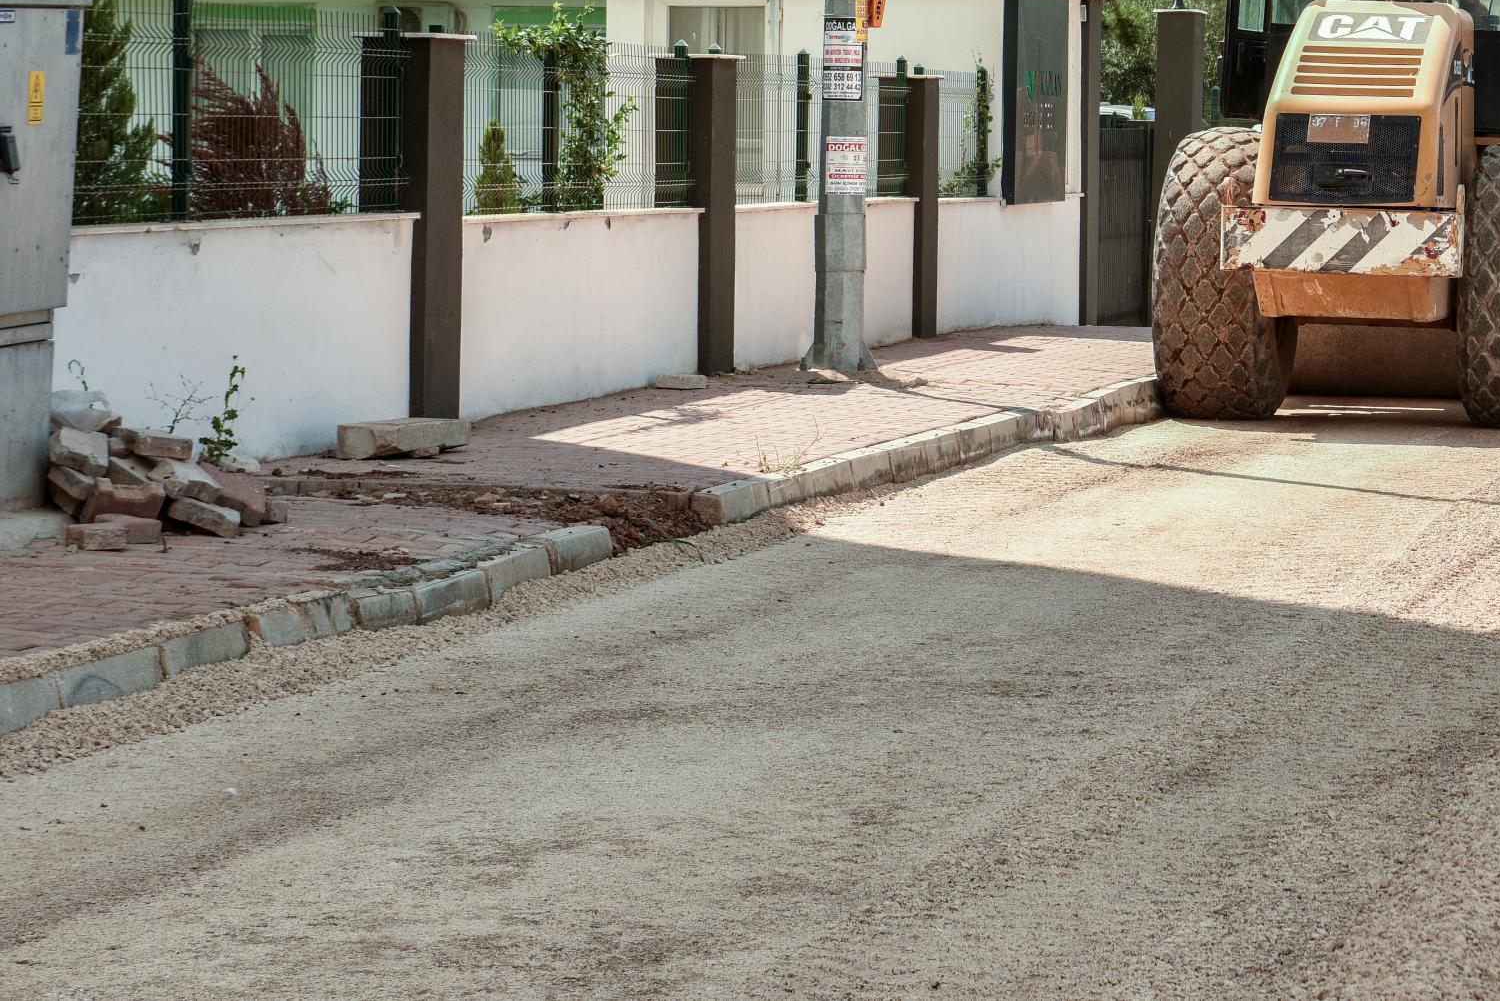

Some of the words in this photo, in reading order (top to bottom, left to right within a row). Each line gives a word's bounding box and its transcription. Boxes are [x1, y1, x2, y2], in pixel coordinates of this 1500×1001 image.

[1317, 14, 1427, 41] CAT
[833, 73, 845, 81] 658
[846, 73, 854, 81] 69
